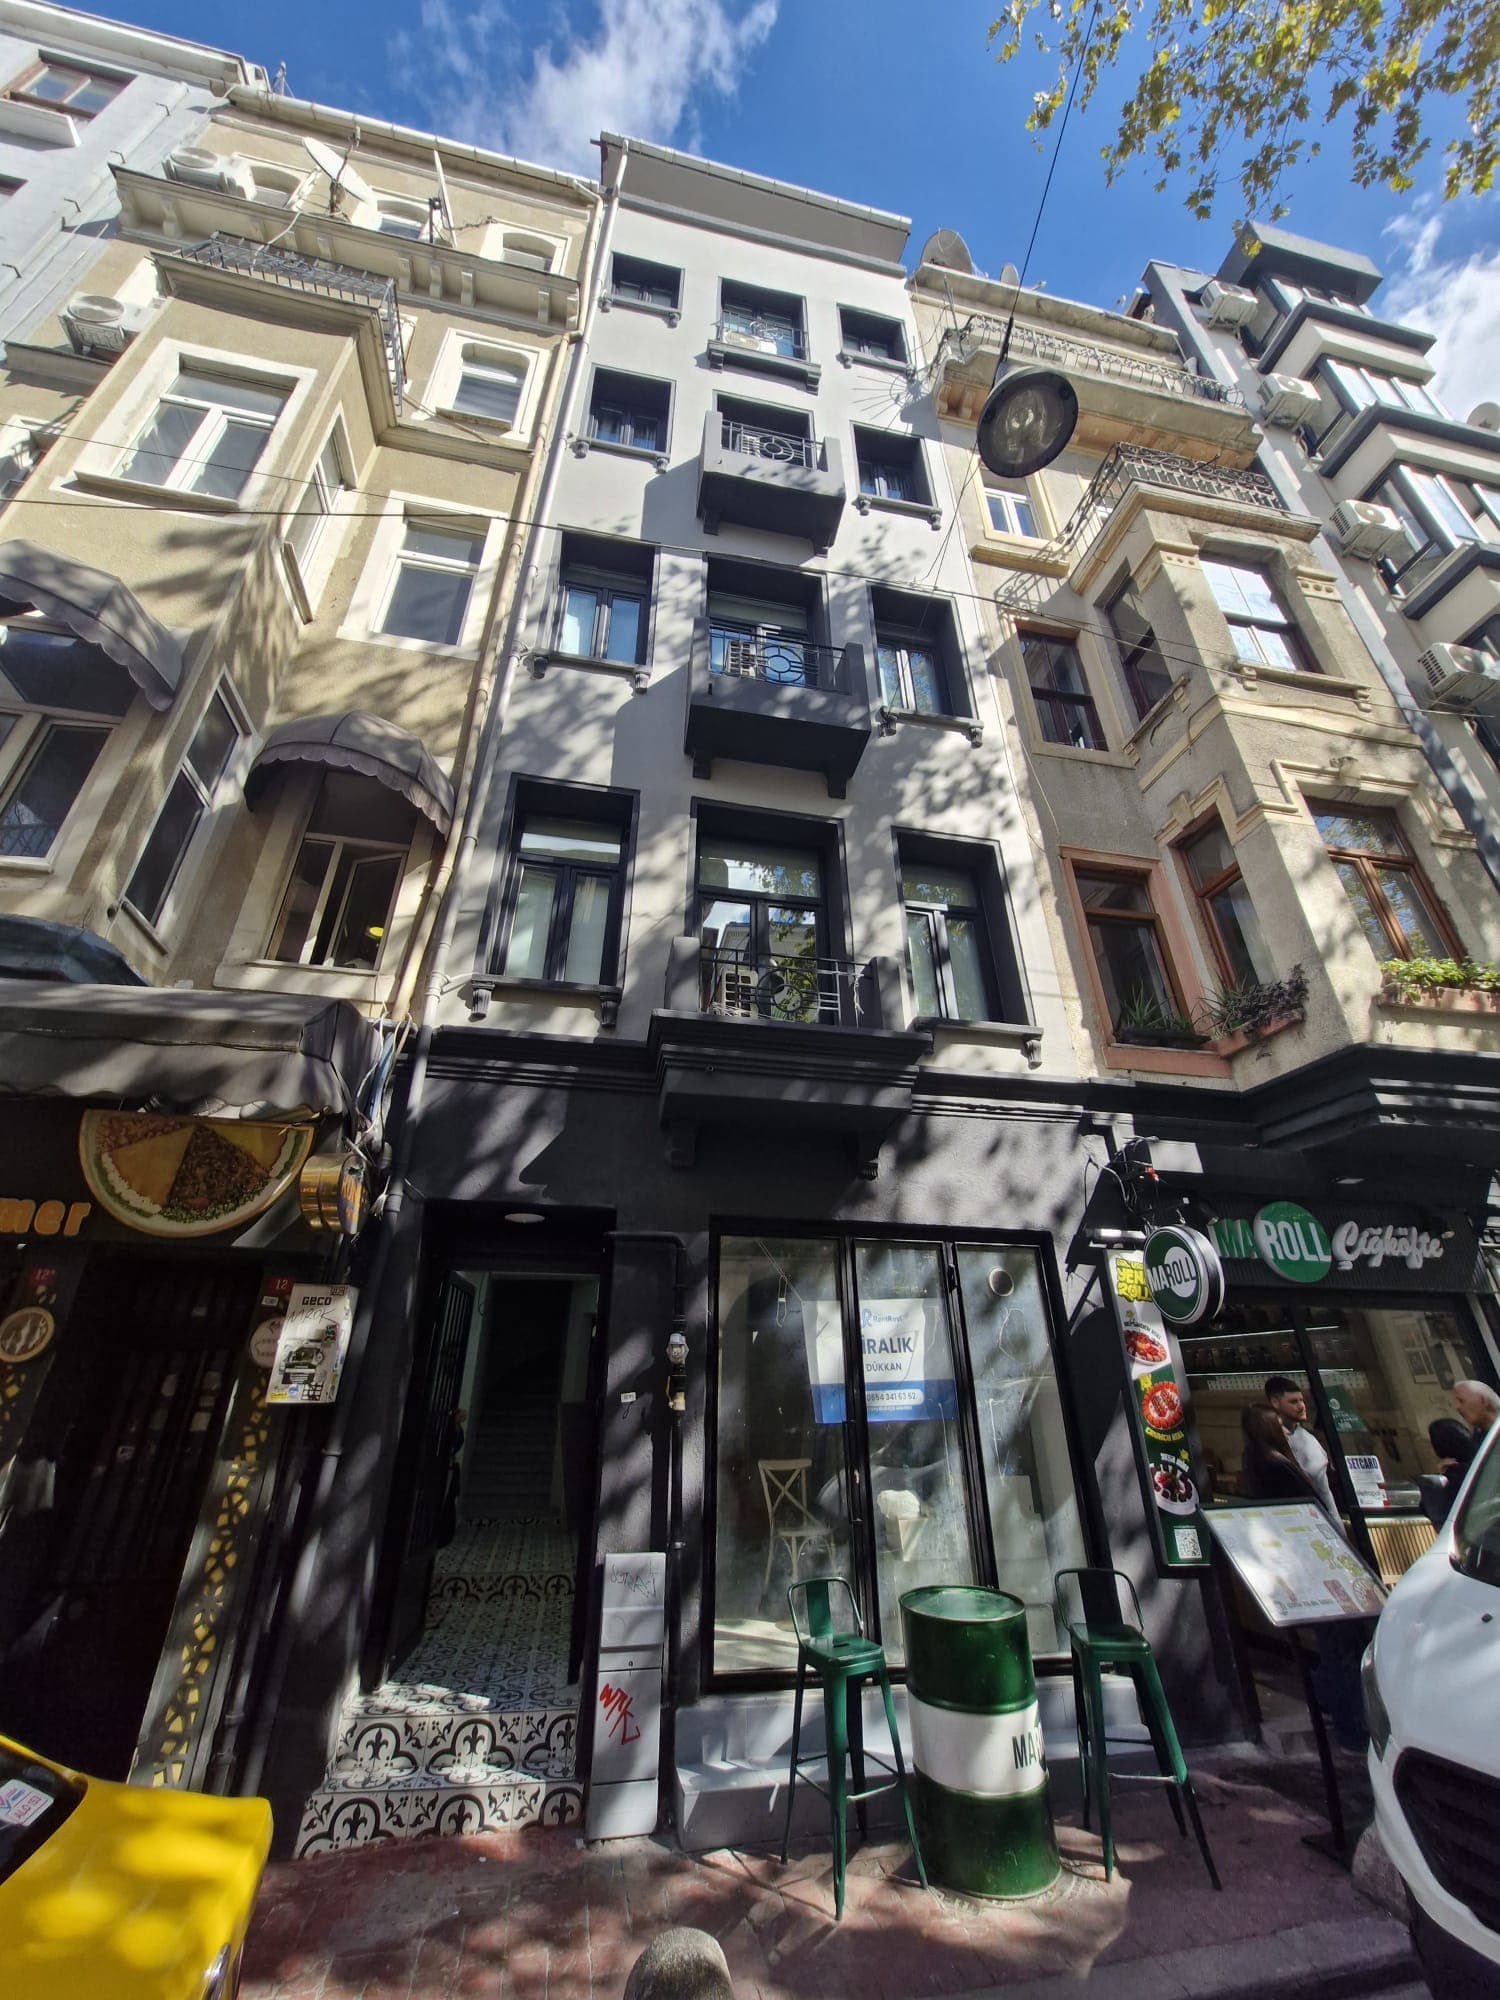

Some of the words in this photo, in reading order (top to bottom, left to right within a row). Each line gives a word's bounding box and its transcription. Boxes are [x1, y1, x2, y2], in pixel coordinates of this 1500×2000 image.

[1207, 1219, 1332, 1262] MAROLL
[1117, 1265, 1146, 1286] YEN
[1146, 1257, 1197, 1292] MAROLL
[862, 1334, 914, 1355] İRALIK
[866, 1362, 902, 1372] DÜKKAN
[1011, 1732, 1043, 1769] MA
